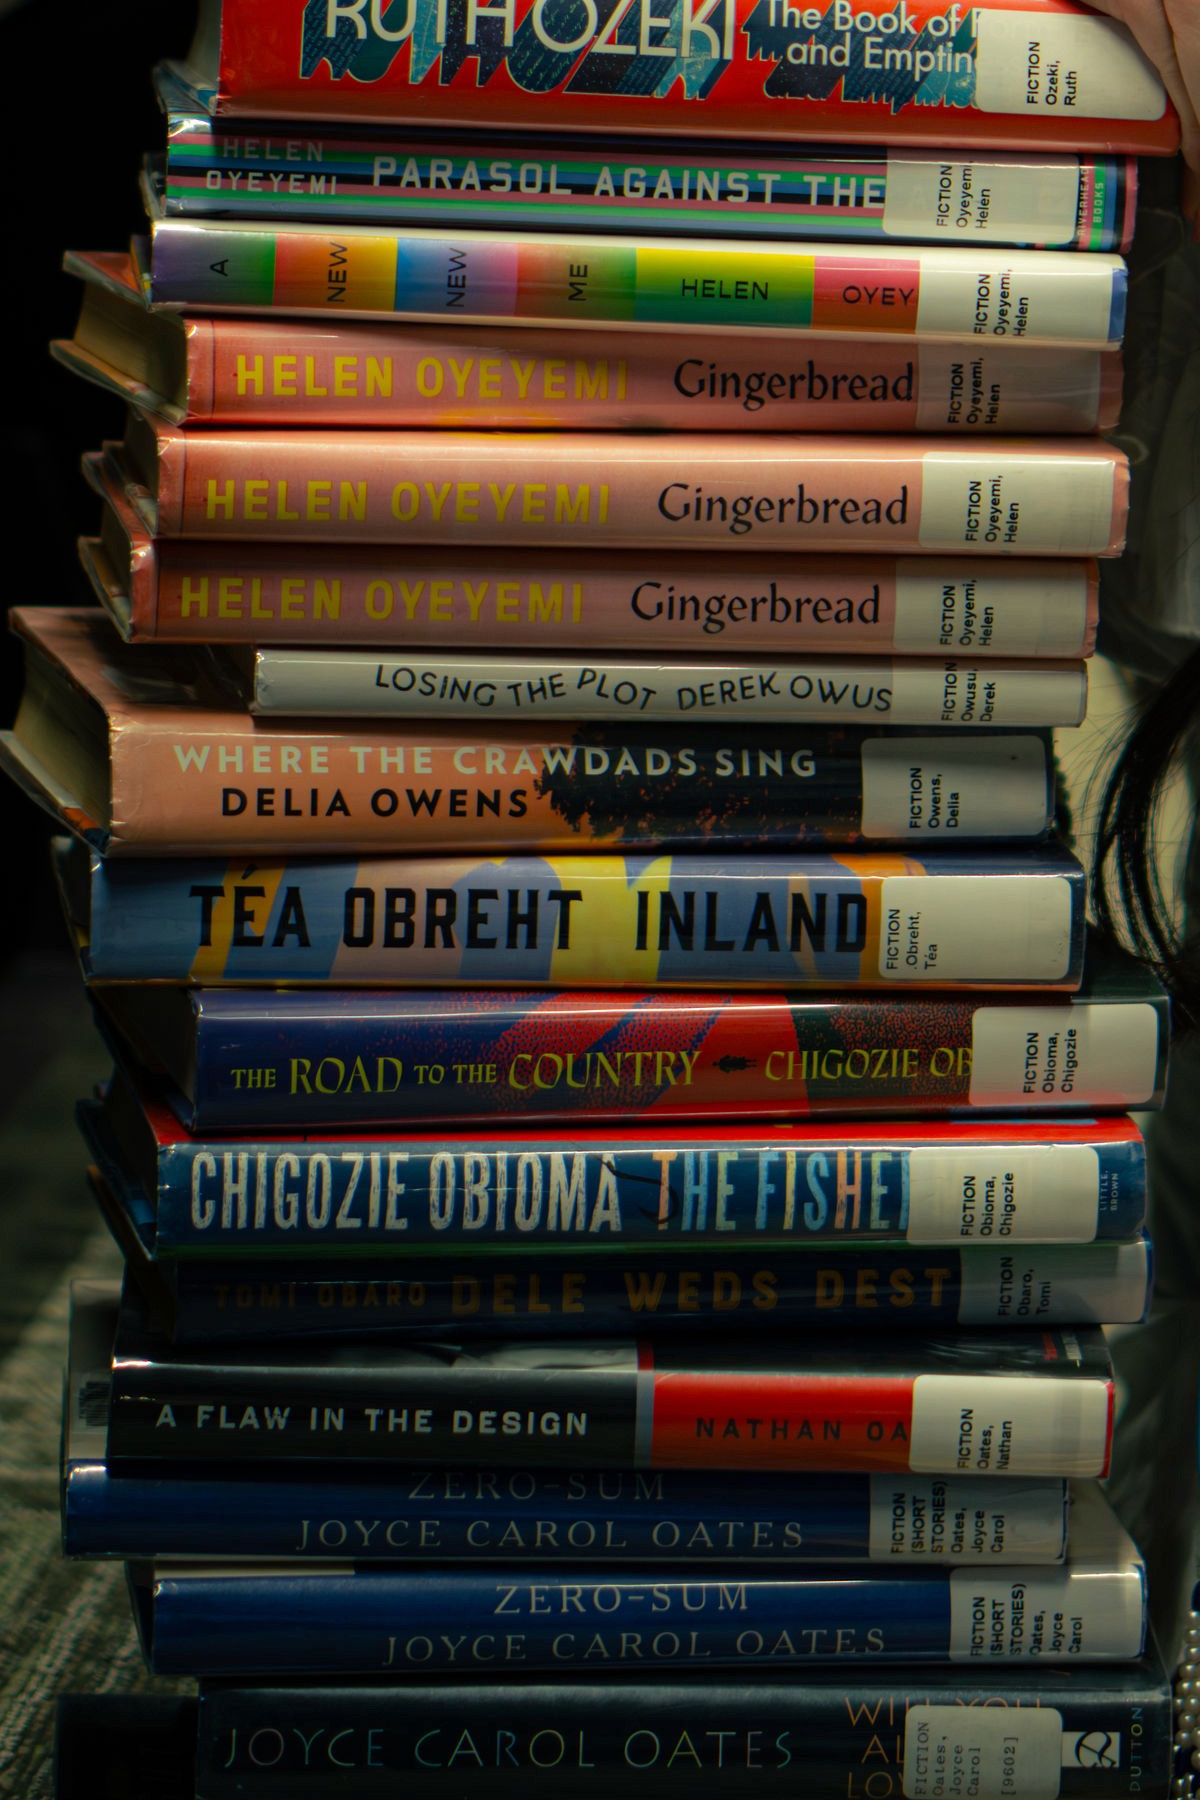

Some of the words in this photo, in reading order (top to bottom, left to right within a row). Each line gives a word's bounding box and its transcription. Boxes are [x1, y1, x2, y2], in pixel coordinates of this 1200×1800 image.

[833, 0, 918, 35] Book
[927, 4, 962, 37] of
[787, 36, 849, 67] and
[864, 37, 977, 82] Emptin
[1026, 41, 1041, 104] FICTION
[1045, 60, 1061, 106] Ozeki,
[1064, 70, 1077, 106] Ruth
[222, 137, 324, 162] HELEN
[205, 169, 337, 195] OYEYEMI
[373, 155, 573, 196] PARASOL
[593, 166, 781, 204] AGAINST
[804, 174, 886, 210] THE
[936, 165, 952, 227] FICTION
[956, 160, 976, 228] Oyeyemi,
[976, 187, 992, 229] Helen
[1077, 168, 1090, 236] RIVERHEAD
[1093, 182, 1104, 223] BOOKS
[209, 258, 229, 277] A
[327, 241, 350, 303] NEW
[445, 247, 468, 307] NEW
[567, 263, 588, 301] ME
[681, 277, 769, 301] HELEN
[974, 272, 992, 335] FICTION
[993, 268, 1013, 336] Oyeyemi,
[1013, 295, 1029, 337] Helen
[236, 354, 394, 398] HELEN
[416, 357, 628, 401] OYEYEMI
[673, 358, 914, 412] Gingerbread
[947, 362, 964, 424] FICTION
[966, 357, 984, 424] Oyeyemi,
[985, 383, 1001, 425] Helen
[206, 479, 368, 521] HELEN
[391, 481, 610, 524] OYEYEMI
[658, 483, 908, 535] Gingerbread
[965, 480, 982, 542] FICTION
[985, 474, 1004, 543] Oyeyemi,
[1003, 502, 1020, 543] Helen
[181, 576, 342, 620] HELEN
[365, 580, 583, 624] OYEYEMI
[631, 581, 881, 634] Gingerbread
[939, 584, 956, 646] FICTION
[959, 578, 977, 646] Oyeyemi,
[979, 606, 994, 647] Helen
[375, 664, 496, 707] LOSING
[507, 672, 567, 707] THE
[576, 667, 657, 711] PLOT
[677, 671, 780, 711] DEREK
[789, 675, 892, 711] OWUS
[941, 661, 958, 721] FICTION
[961, 667, 979, 722] Owusu,
[980, 681, 996, 722] Derek
[173, 745, 330, 773] WHERE
[350, 745, 433, 774] THE
[453, 746, 697, 777] CRAWDADS
[714, 748, 817, 777] SING
[221, 787, 352, 817] DELIA
[370, 788, 527, 818] OWENS
[909, 766, 922, 829] FICTION
[927, 772, 943, 829] Owens,
[946, 791, 960, 829] Delia
[189, 864, 311, 948] TÉA
[343, 887, 583, 950] OBREHT
[635, 891, 868, 952] INLAND
[885, 908, 901, 970] FICTION
[924, 943, 939, 970] Téa
[230, 1067, 277, 1089] THE
[288, 1055, 404, 1095] ROAD
[413, 1064, 445, 1085] TO
[452, 1062, 497, 1084] THE
[508, 1050, 701, 1090] COUNTRY
[764, 1048, 919, 1082] CHIGOZIE
[1023, 1031, 1039, 1094] FICTION
[1042, 1031, 1060, 1094] Obioma,
[1061, 1028, 1078, 1093] Chigozie
[190, 1151, 410, 1231] CHIGOZIE
[428, 1150, 622, 1233] OBIOMA
[651, 1150, 739, 1232] THE
[960, 1175, 977, 1236] FICTION
[980, 1175, 997, 1236] Obioma,
[998, 1172, 1015, 1237] Chigozie
[1110, 1172, 1119, 1211] BROWN
[216, 1282, 297, 1310] TOMI
[317, 1281, 427, 1308] OBARO
[451, 1272, 586, 1316] DELE
[623, 1268, 781, 1312] WEDS
[815, 1267, 952, 1308] DEST
[998, 1256, 1013, 1317] FICTION
[1016, 1268, 1035, 1317] Obaro,
[1037, 1280, 1053, 1316] Tomi
[155, 1404, 177, 1429] A
[196, 1404, 292, 1431] FLAW
[310, 1406, 345, 1432] IN
[364, 1408, 433, 1434] THE
[452, 1408, 588, 1436] DESIGN
[695, 1417, 842, 1441] NATHAN
[957, 1407, 974, 1469] FICTION
[978, 1425, 995, 1469] Oates,
[996, 1420, 1012, 1469] Nathan
[407, 1471, 666, 1502] ZERO-SUM
[296, 1519, 442, 1551] JOYCE
[466, 1520, 628, 1548] CAROL
[652, 1521, 803, 1549] OATES
[891, 1493, 906, 1553] FICTION
[911, 1495, 926, 1554] (SHORT
[931, 1480, 948, 1553] STORIES)
[951, 1507, 967, 1553] Oates,
[971, 1510, 985, 1553] Joyce
[991, 1514, 1005, 1553] Carol
[493, 1583, 749, 1614] ZERO-SUM
[1010, 1583, 1027, 1656] STORIES)
[381, 1633, 527, 1667] JOYCE
[551, 1631, 712, 1661] CAROL
[735, 1627, 885, 1657] OATES
[970, 1597, 985, 1656] FICTION
[990, 1599, 1005, 1656] (SHORT
[1029, 1610, 1046, 1656] Oates,
[1049, 1612, 1063, 1655] Joyce
[1068, 1617, 1082, 1654] Carol
[223, 1727, 384, 1769] JOYCE
[413, 1728, 596, 1769] CAROL
[623, 1729, 792, 1768] OATES
[914, 1722, 929, 1796] FICTION
[932, 1735, 948, 1796] Oates,
[950, 1744, 963, 1795] Joyce
[967, 1747, 981, 1796] Carol
[1130, 1707, 1144, 1792] DUTTON
